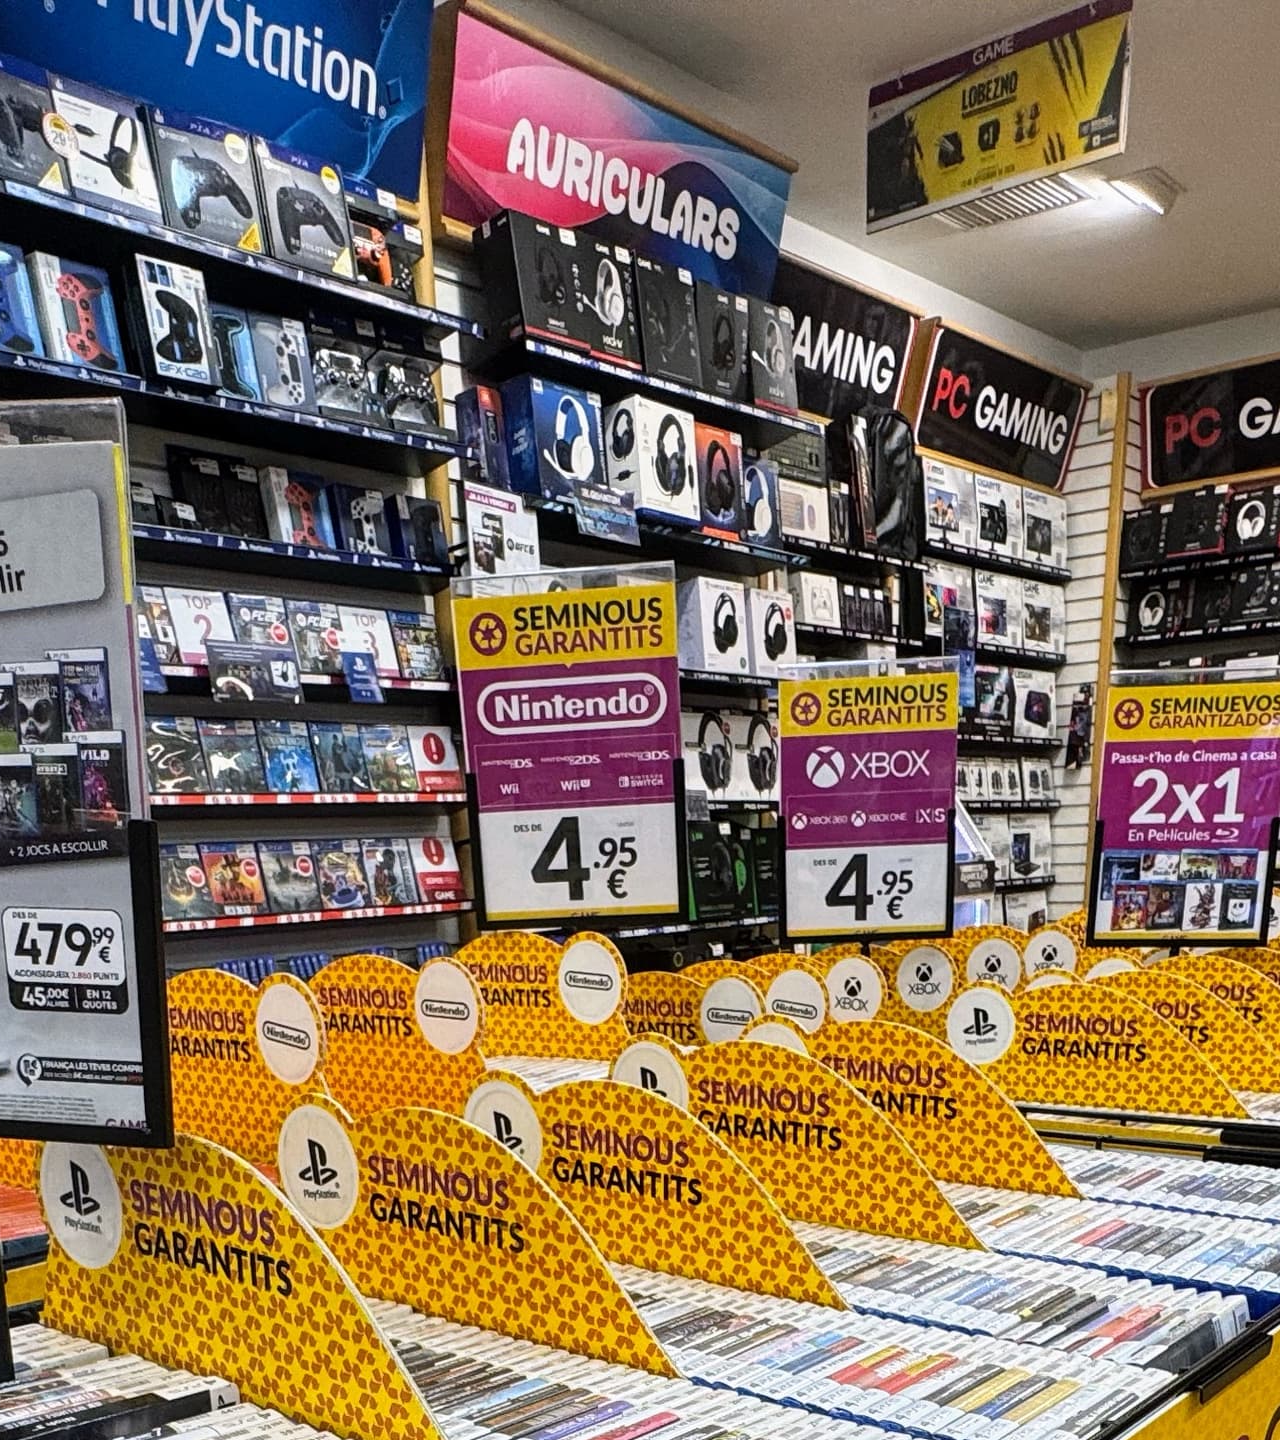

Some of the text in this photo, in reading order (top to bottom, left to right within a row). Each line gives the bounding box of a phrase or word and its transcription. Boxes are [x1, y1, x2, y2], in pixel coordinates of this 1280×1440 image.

[96, 0, 378, 117] ayStation
[972, 36, 1014, 66] GAME
[961, 70, 1018, 110] LOBEZNO
[506, 118, 741, 261] AURICULARS
[790, 314, 896, 394] AMING
[932, 367, 1068, 455] PC GAMING
[1165, 407, 1221, 454] PC
[186, 594, 212, 610] TOP
[513, 597, 663, 632] SEMINOUS
[352, 613, 377, 627] TOP
[514, 625, 663, 656] GARANTITS
[494, 688, 650, 722] Nintendo
[827, 683, 949, 709] SEMINOUS
[826, 704, 947, 728] GARANTITS
[1149, 712, 1280, 730] GARANTIZADOS
[851, 750, 931, 780] XBOX
[1175, 750, 1190, 762] de
[1192, 750, 1238, 762] Cinema
[1240, 753, 1248, 761] a
[1250, 752, 1277, 761] casa
[500, 783, 520, 795] Wii
[630, 779, 664, 788] SWITCH
[1128, 767, 1244, 825] 2x1
[513, 824, 543, 833] DES DE
[1128, 830, 1144, 841] En
[435, 891, 456, 900] GAME
[568, 973, 610, 989] Nintendo
[907, 981, 941, 996] XBOX
[82, 1000, 118, 1010] QUOTES
[86, 989, 112, 1000] EN 12
[320, 985, 408, 1010] SEMINOUS
[835, 996, 869, 1013] XBOX
[266, 1024, 307, 1046] Nintendo
[1023, 1013, 1139, 1037] SEMINOUS
[1021, 1036, 1147, 1063] GARANTITS
[697, 1079, 830, 1118] SEMINOUS
[697, 1109, 842, 1152] GARANTITS
[551, 1122, 690, 1169] SEMINOUS
[303, 1188, 340, 1201] PlayStation
[367, 1155, 509, 1210] SEMINOUS
[552, 1157, 703, 1206] GARANTITS
[63, 1217, 102, 1237] PlayStation
[129, 1180, 277, 1248] SEMINOUS
[369, 1193, 525, 1253] GARANTITS
[133, 1222, 294, 1299] GARANTITS
